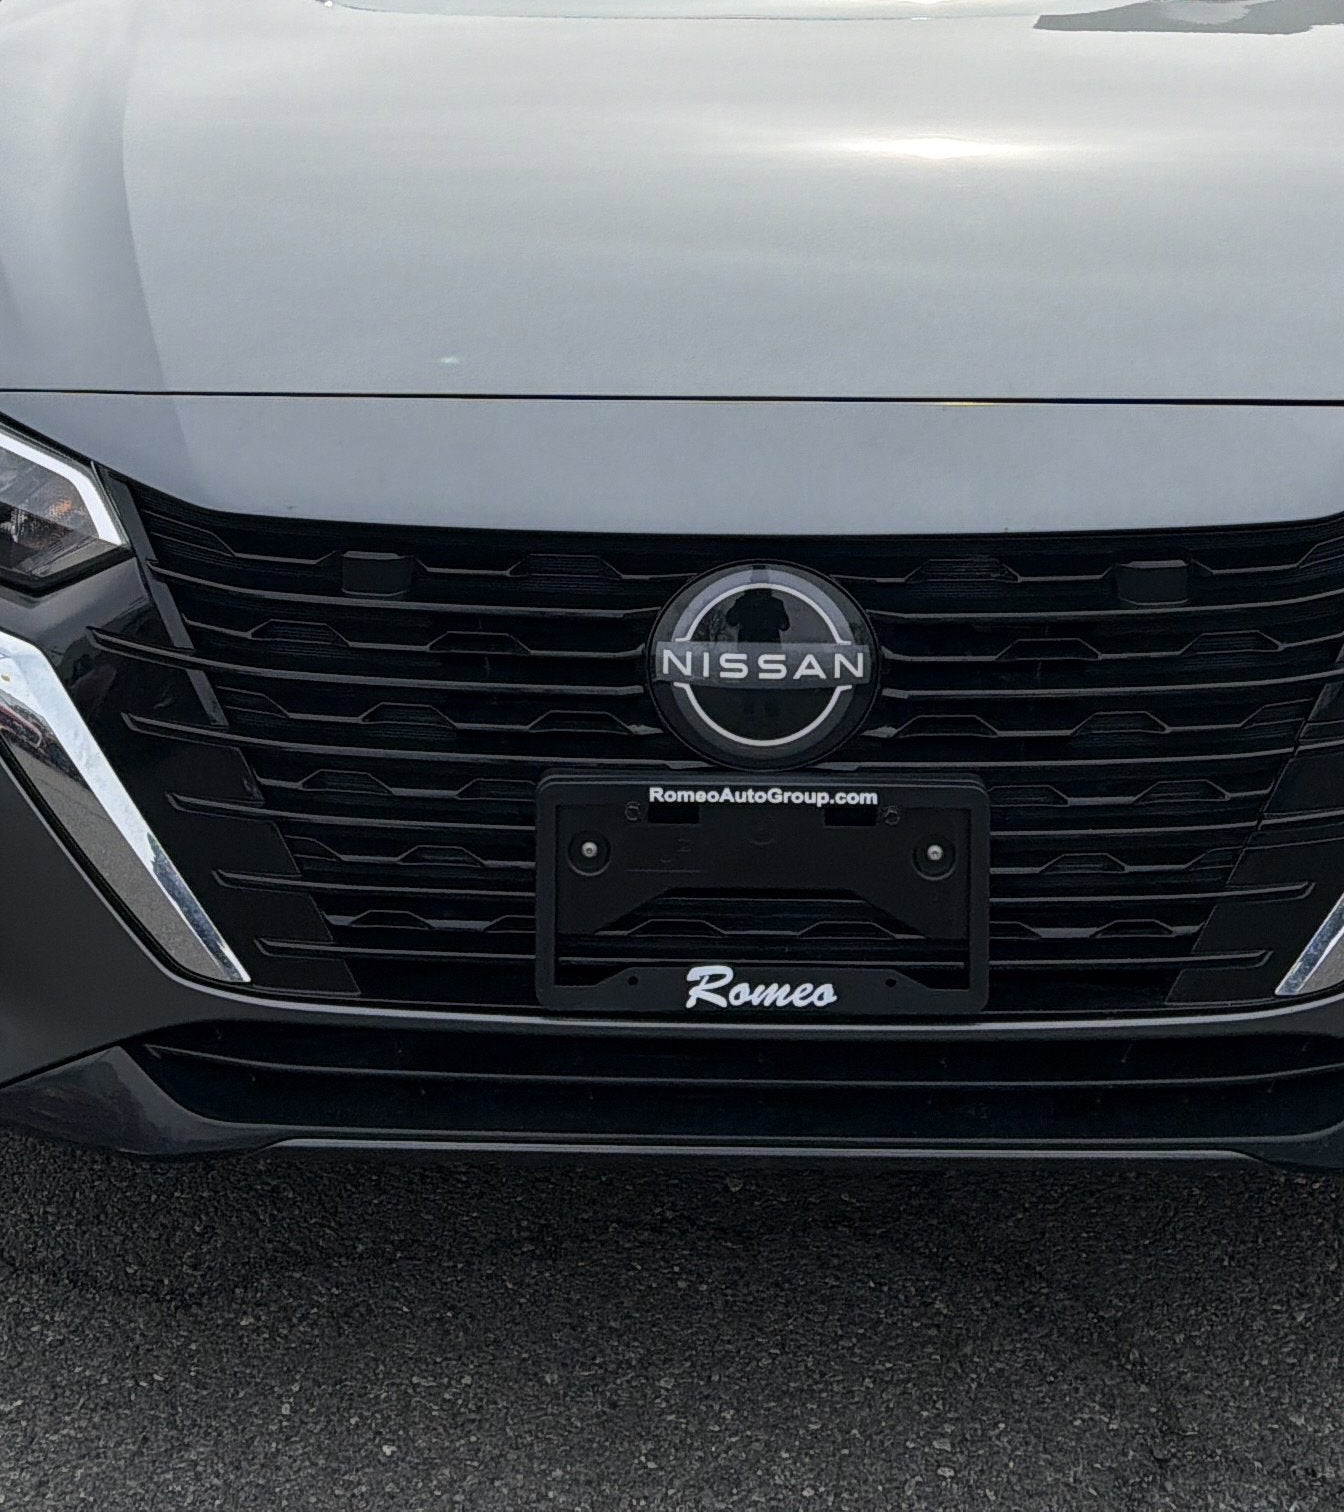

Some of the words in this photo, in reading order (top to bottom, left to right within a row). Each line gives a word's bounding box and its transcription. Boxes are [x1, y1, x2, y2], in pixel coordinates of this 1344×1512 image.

[663, 649, 864, 680] NISSAN
[649, 787, 878, 807] RomeoAutoGroup.com
[686, 965, 837, 1008] Romeo
